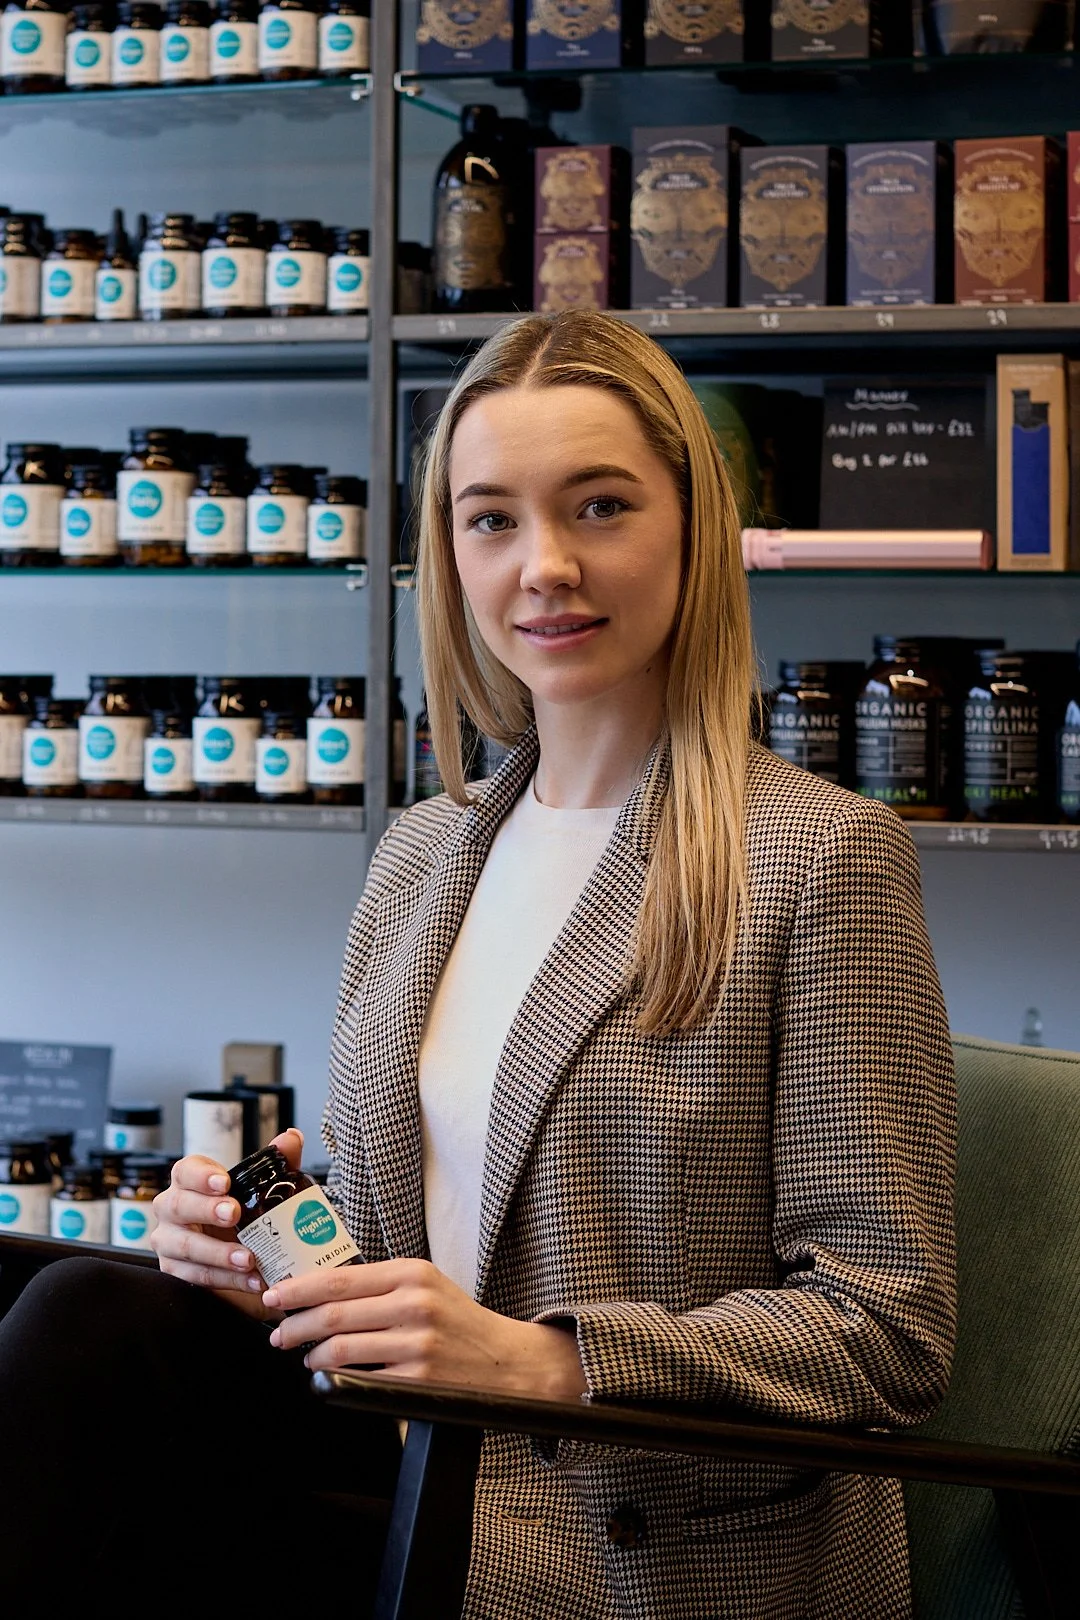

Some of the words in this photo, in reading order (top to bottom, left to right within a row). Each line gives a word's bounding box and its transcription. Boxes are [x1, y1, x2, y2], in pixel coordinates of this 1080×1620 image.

[964, 704, 1040, 720] ORGANIC
[964, 719, 1039, 735] SPIRULINA
[874, 787, 927, 801] HEALH
[990, 785, 1038, 800] HEALH
[298, 1219, 319, 1237] High
[317, 1214, 332, 1226] Five
[315, 1243, 352, 1267] VIRIDIAN
